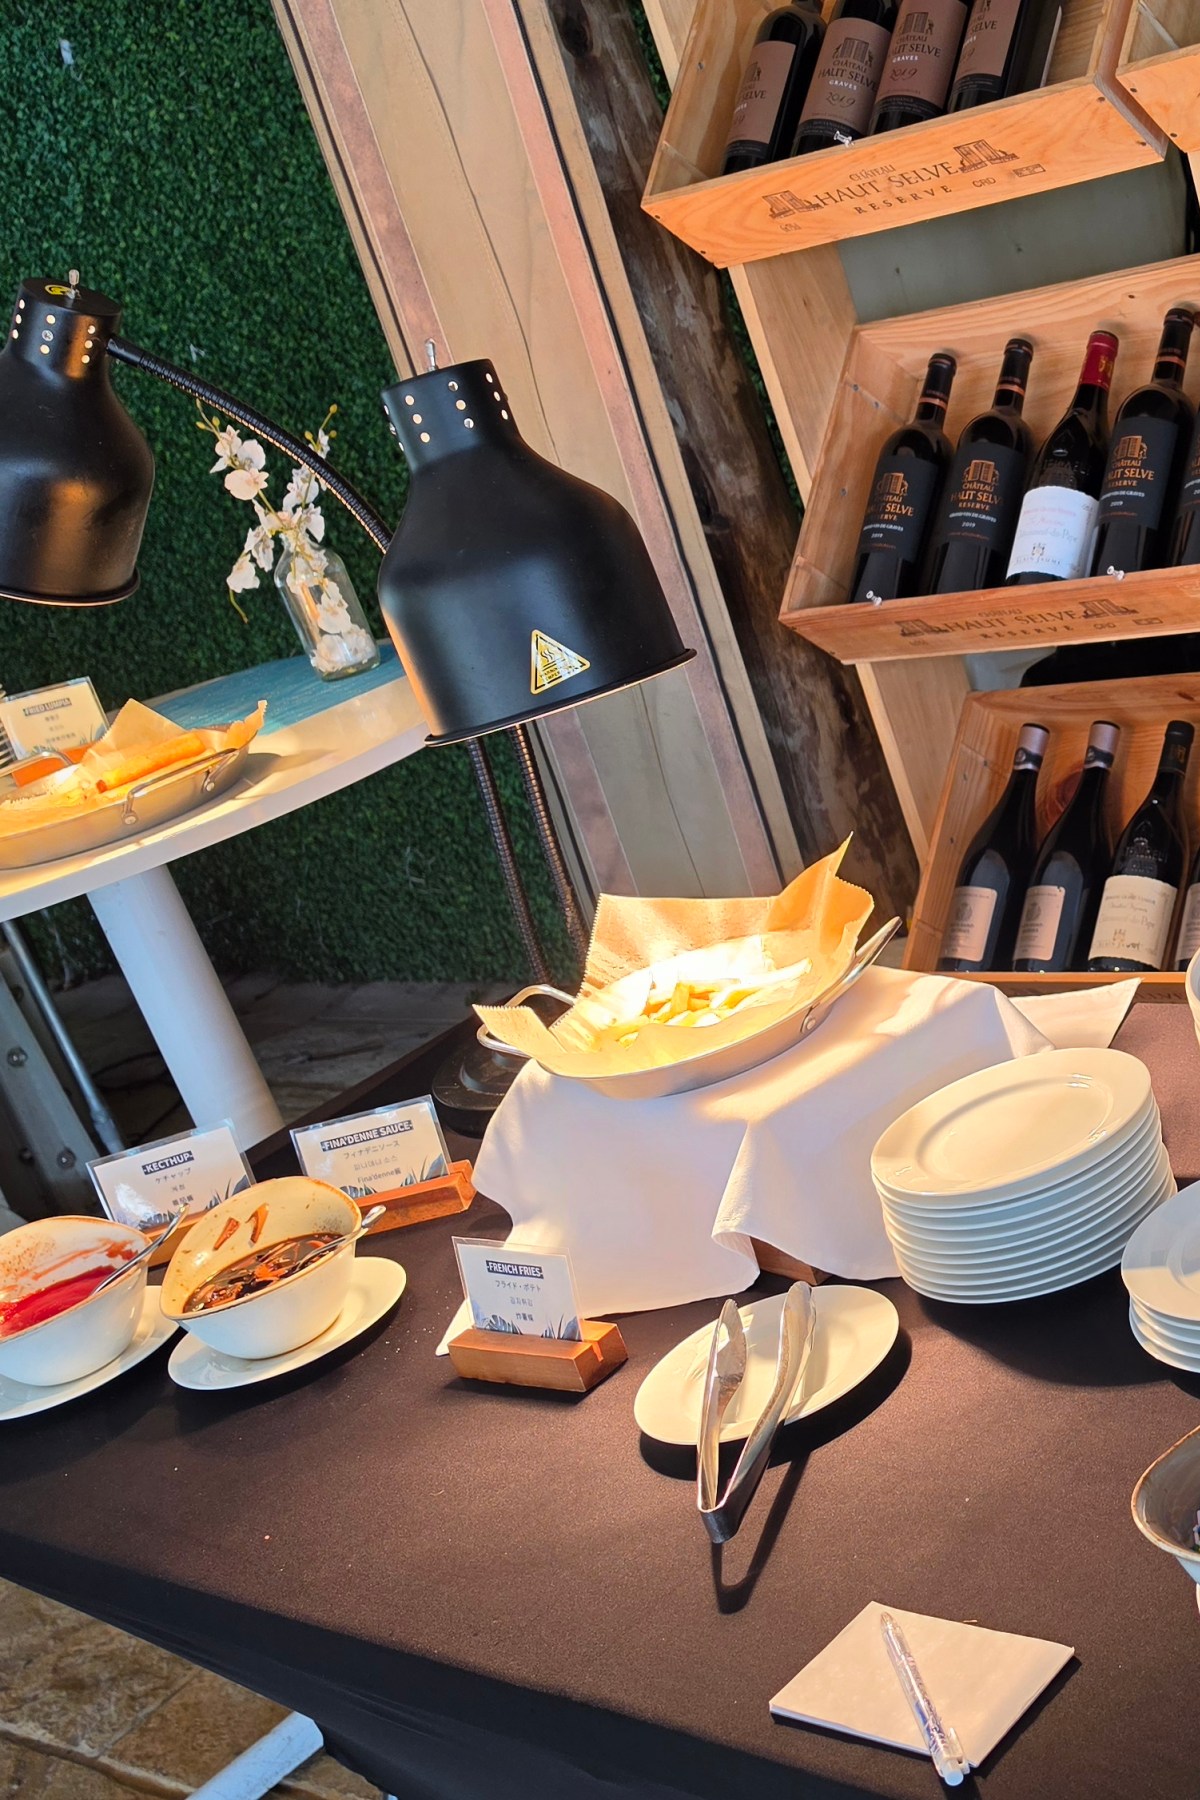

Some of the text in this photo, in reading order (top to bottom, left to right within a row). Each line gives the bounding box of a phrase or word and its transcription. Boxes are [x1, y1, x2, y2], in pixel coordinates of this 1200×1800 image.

[910, 43, 942, 57] SELVE
[829, 79, 857, 91] GRAVES
[848, 68, 877, 92] SELVE
[849, 164, 897, 182] CHÂTEAU
[814, 161, 961, 208] HAUT SELVE
[972, 177, 997, 189] CRD
[853, 185, 953, 214] RESERVE
[1124, 468, 1155, 480] SELVE
[962, 481, 995, 492] CHÂTEAU
[885, 502, 914, 516] SELVE
[958, 502, 990, 511] RESERVE
[947, 608, 1079, 633] HAUT SELVE
[981, 625, 1075, 639] RESERVE
[343, 1140, 401, 1160] フィナデニソース
[155, 1166, 192, 1184] ケチャップ
[495, 1279, 542, 1293] フライド・ポテト
